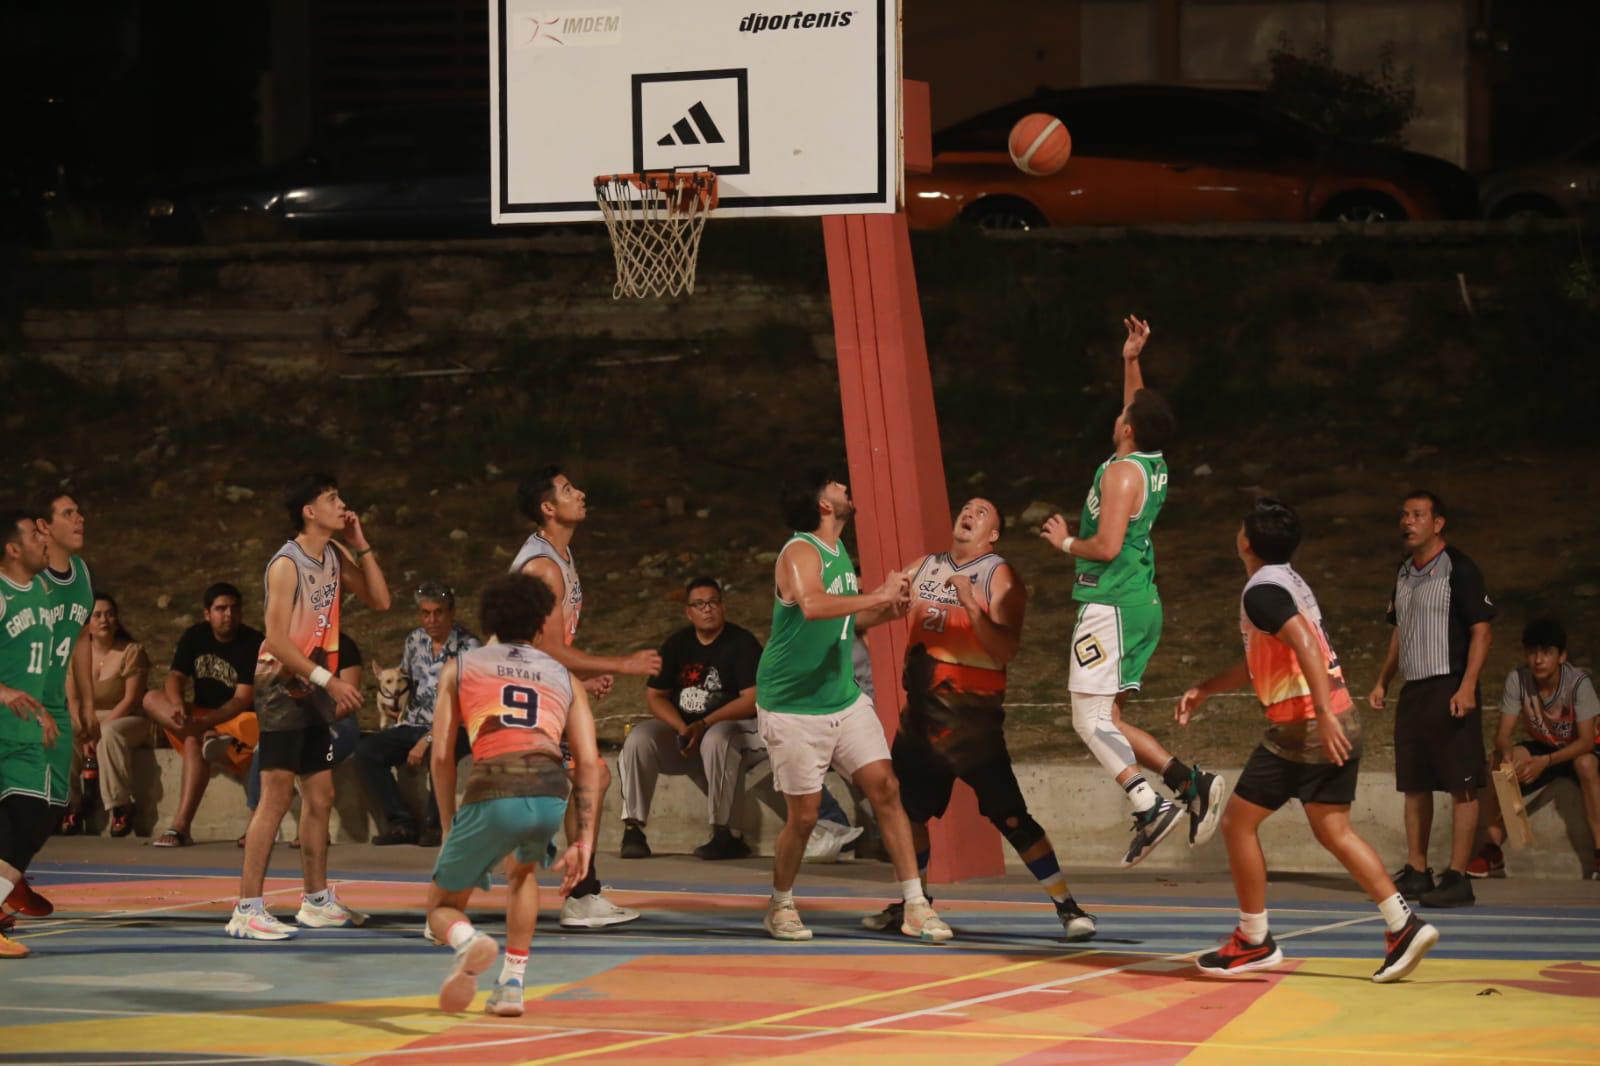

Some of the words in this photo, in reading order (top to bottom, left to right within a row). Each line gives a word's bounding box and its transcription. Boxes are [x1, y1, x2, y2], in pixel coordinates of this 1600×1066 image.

[562, 16, 620, 33] IMDEM
[739, 11, 853, 33] dportenis
[923, 606, 948, 633] 21
[27, 642, 43, 674] 11
[496, 664, 541, 681] BRYAN
[501, 683, 540, 729] 9
